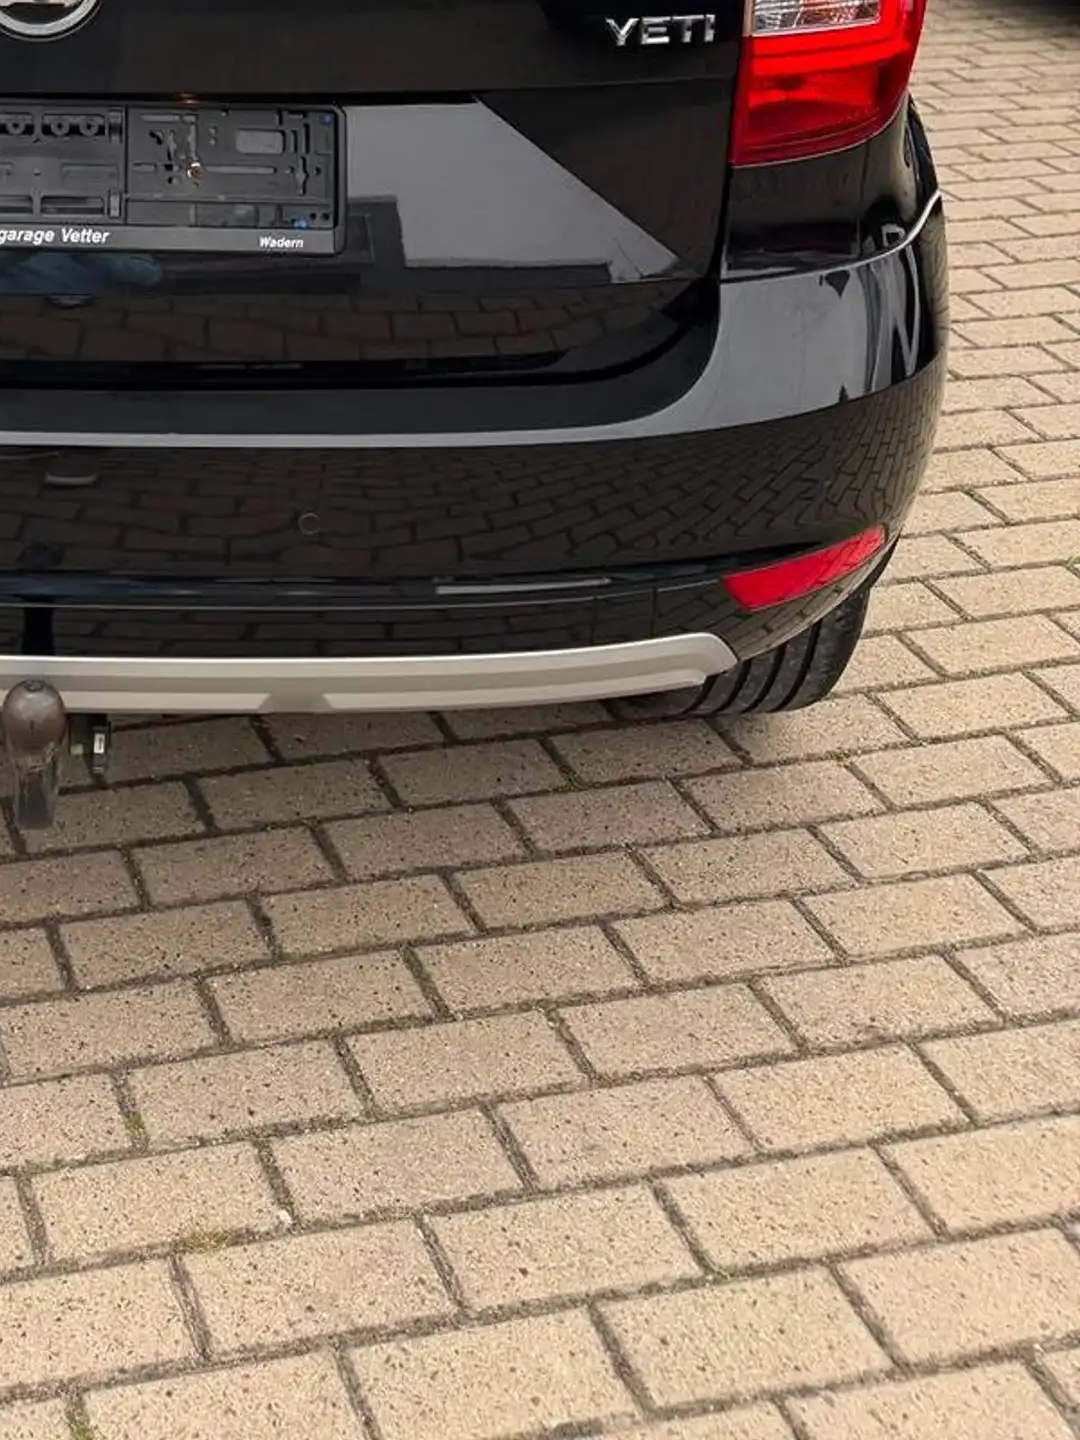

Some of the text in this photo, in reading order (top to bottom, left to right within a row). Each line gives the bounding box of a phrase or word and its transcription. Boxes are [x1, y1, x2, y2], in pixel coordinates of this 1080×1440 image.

[605, 14, 716, 46] YETI
[61, 228, 110, 243] Vetter
[260, 236, 304, 248] Wadern
